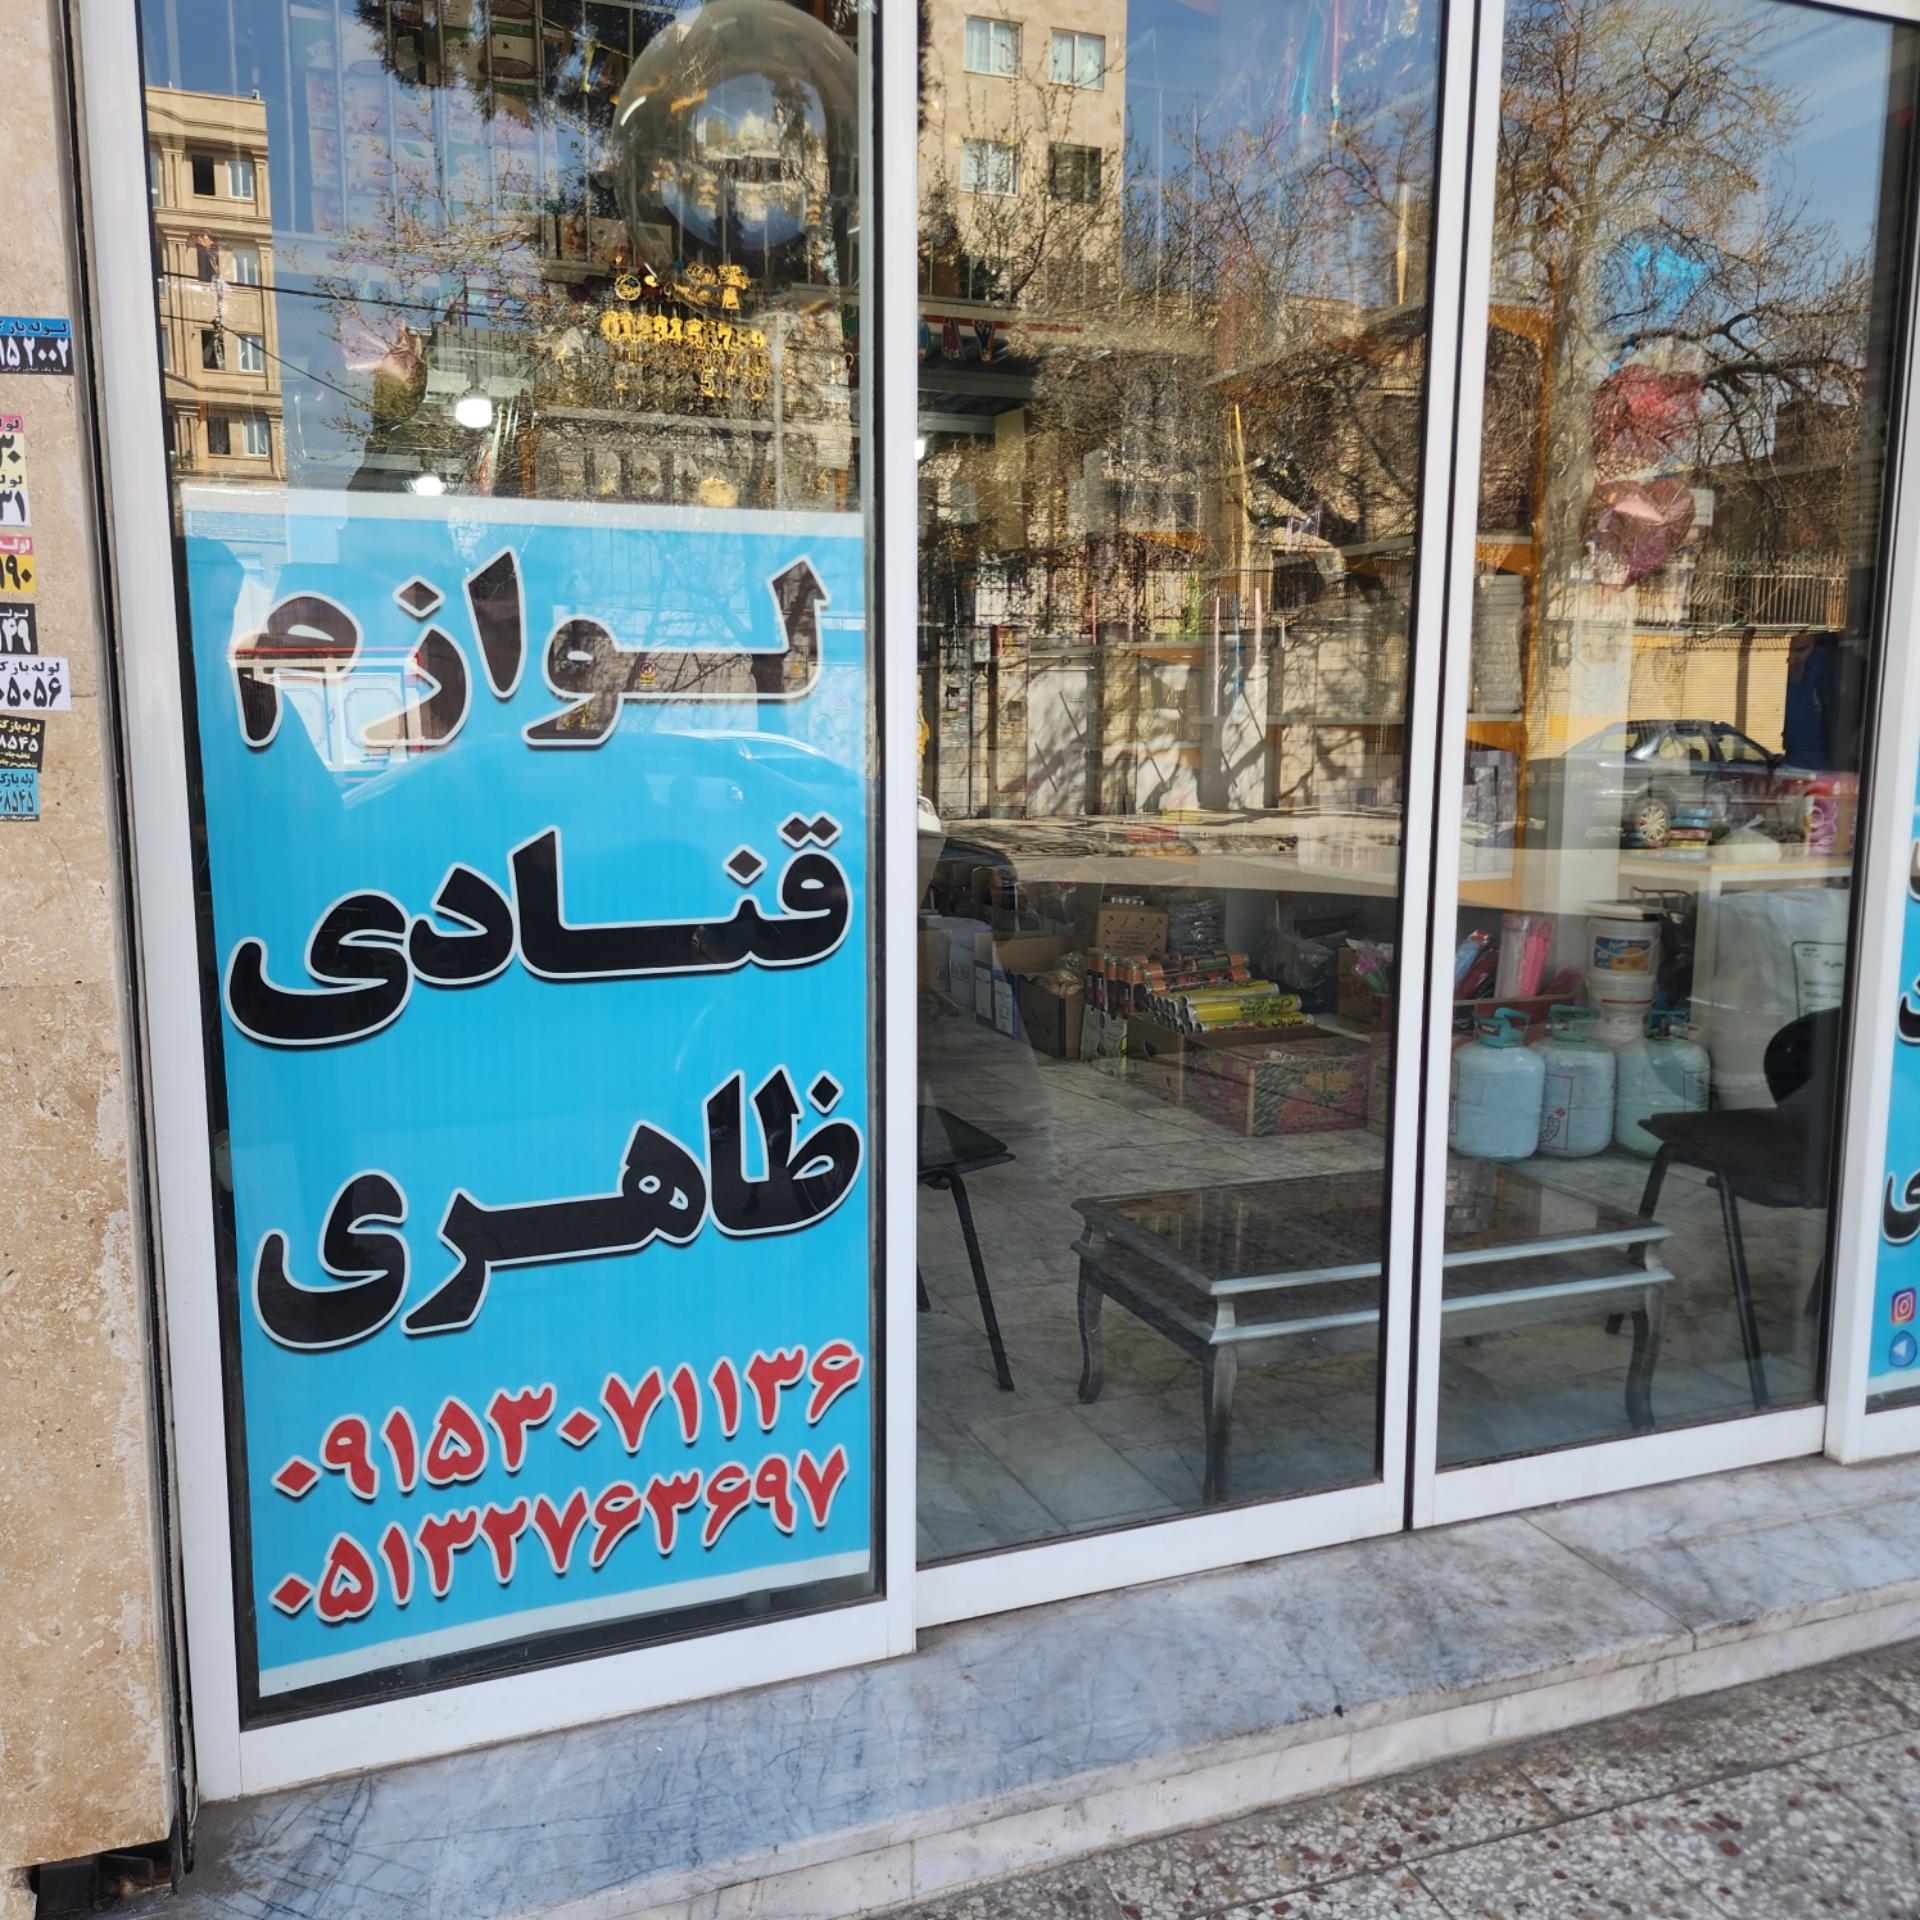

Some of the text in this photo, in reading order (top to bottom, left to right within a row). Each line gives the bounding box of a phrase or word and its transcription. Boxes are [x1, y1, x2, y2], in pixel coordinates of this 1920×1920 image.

[0, 617, 31, 653] ۴۹
[10, 661, 29, 676] باز
[31, 661, 60, 676] لوله
[229, 547, 831, 749] لوازم
[0, 789, 34, 813] ۸۵۴۵
[225, 813, 851, 1046] قنادی
[252, 1065, 865, 1350] ظاهری
[271, 1339, 862, 1500] ۰۹۱۵۳۰۷۱۱۳۶
[270, 1446, 848, 1622] ۰۵۱۳۲۷۶۳۶۹۷
